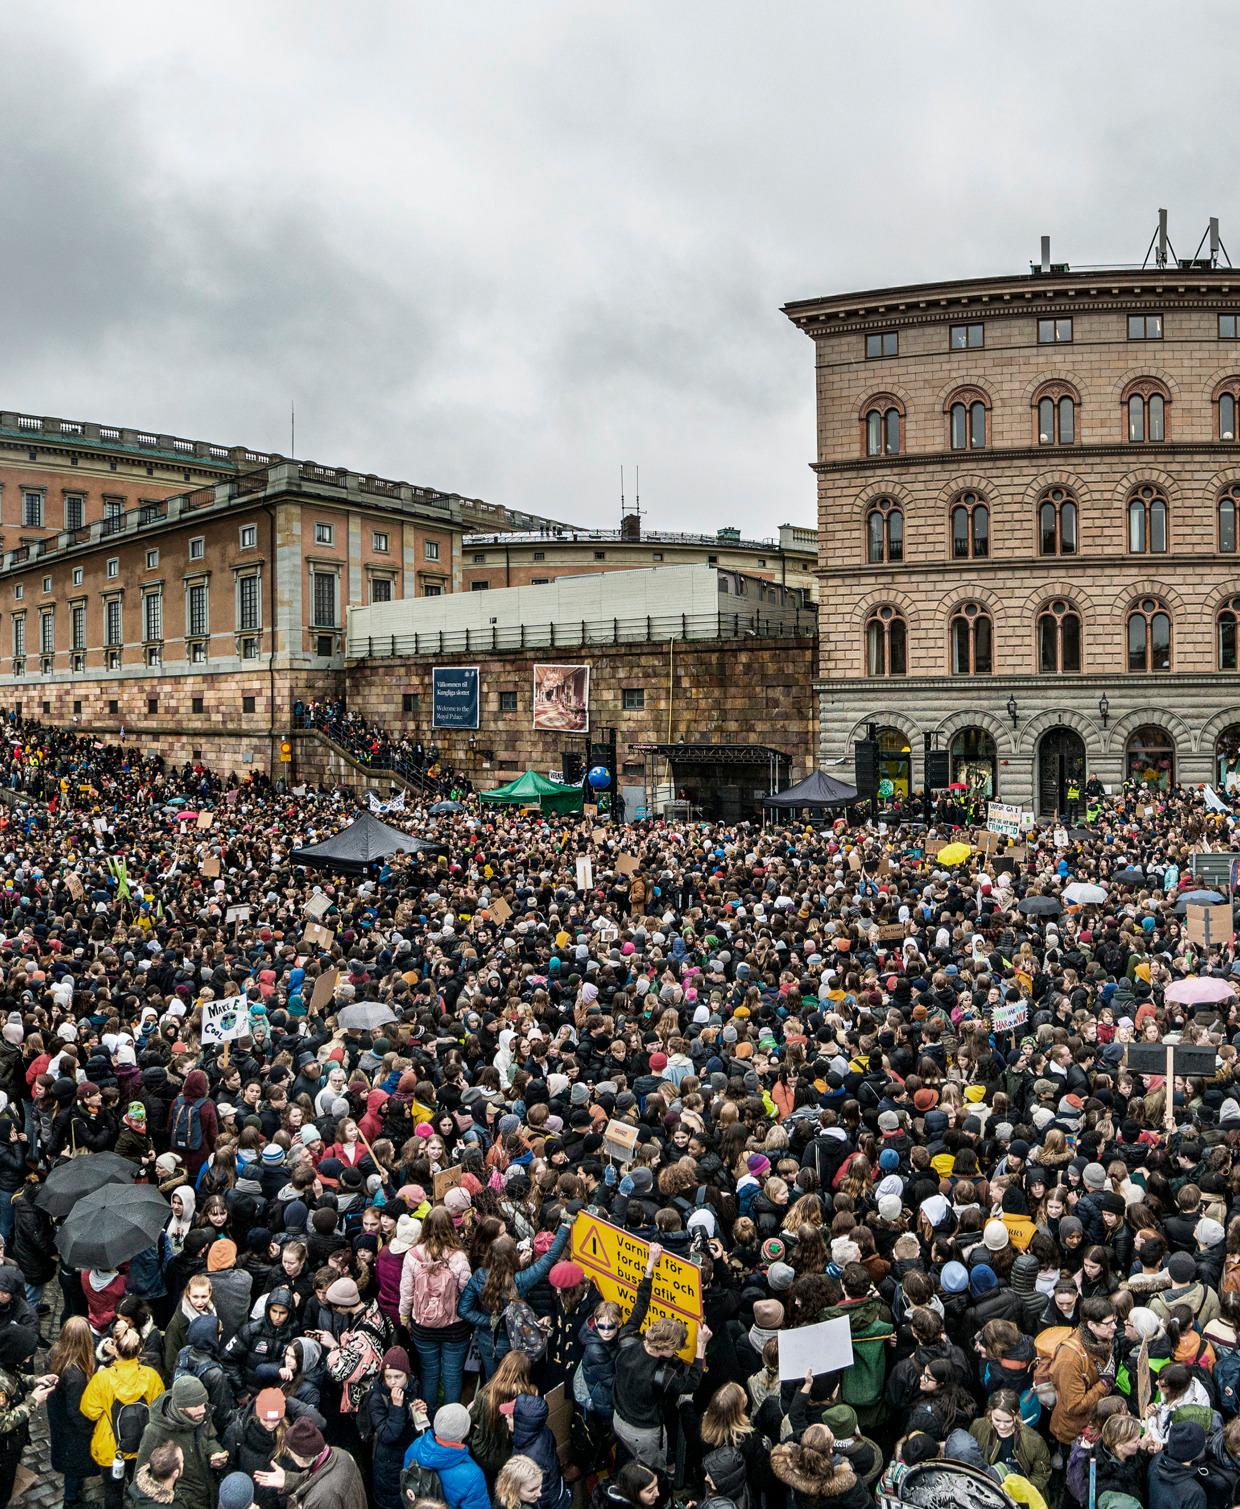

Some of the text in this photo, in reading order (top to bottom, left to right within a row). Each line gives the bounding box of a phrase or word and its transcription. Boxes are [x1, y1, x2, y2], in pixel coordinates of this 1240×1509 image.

[204, 1022, 223, 1040] COOL
[665, 1258, 683, 1275] för
[673, 1281, 695, 1297] och
